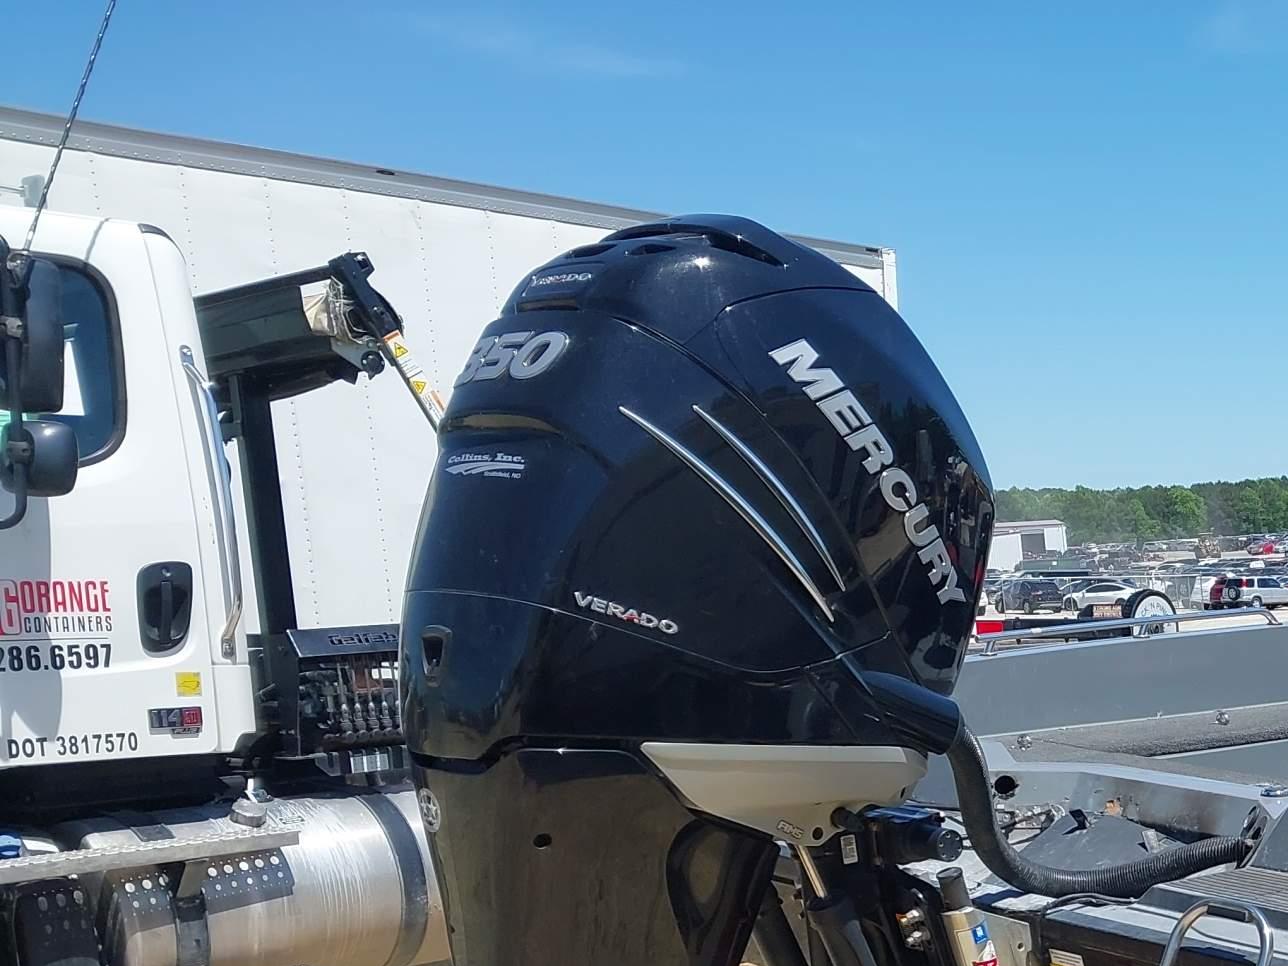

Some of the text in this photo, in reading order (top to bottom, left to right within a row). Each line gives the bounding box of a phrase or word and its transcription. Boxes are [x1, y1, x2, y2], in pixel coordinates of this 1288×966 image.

[494, 453, 525, 463] Inc.
[769, 338, 967, 606] MERCURY
[20, 580, 111, 613] ORANGE
[24, 615, 113, 633] CONTAINERS
[574, 591, 679, 634] VERADO
[151, 709, 181, 727] 114
[7, 732, 139, 759] DOT 3817570
